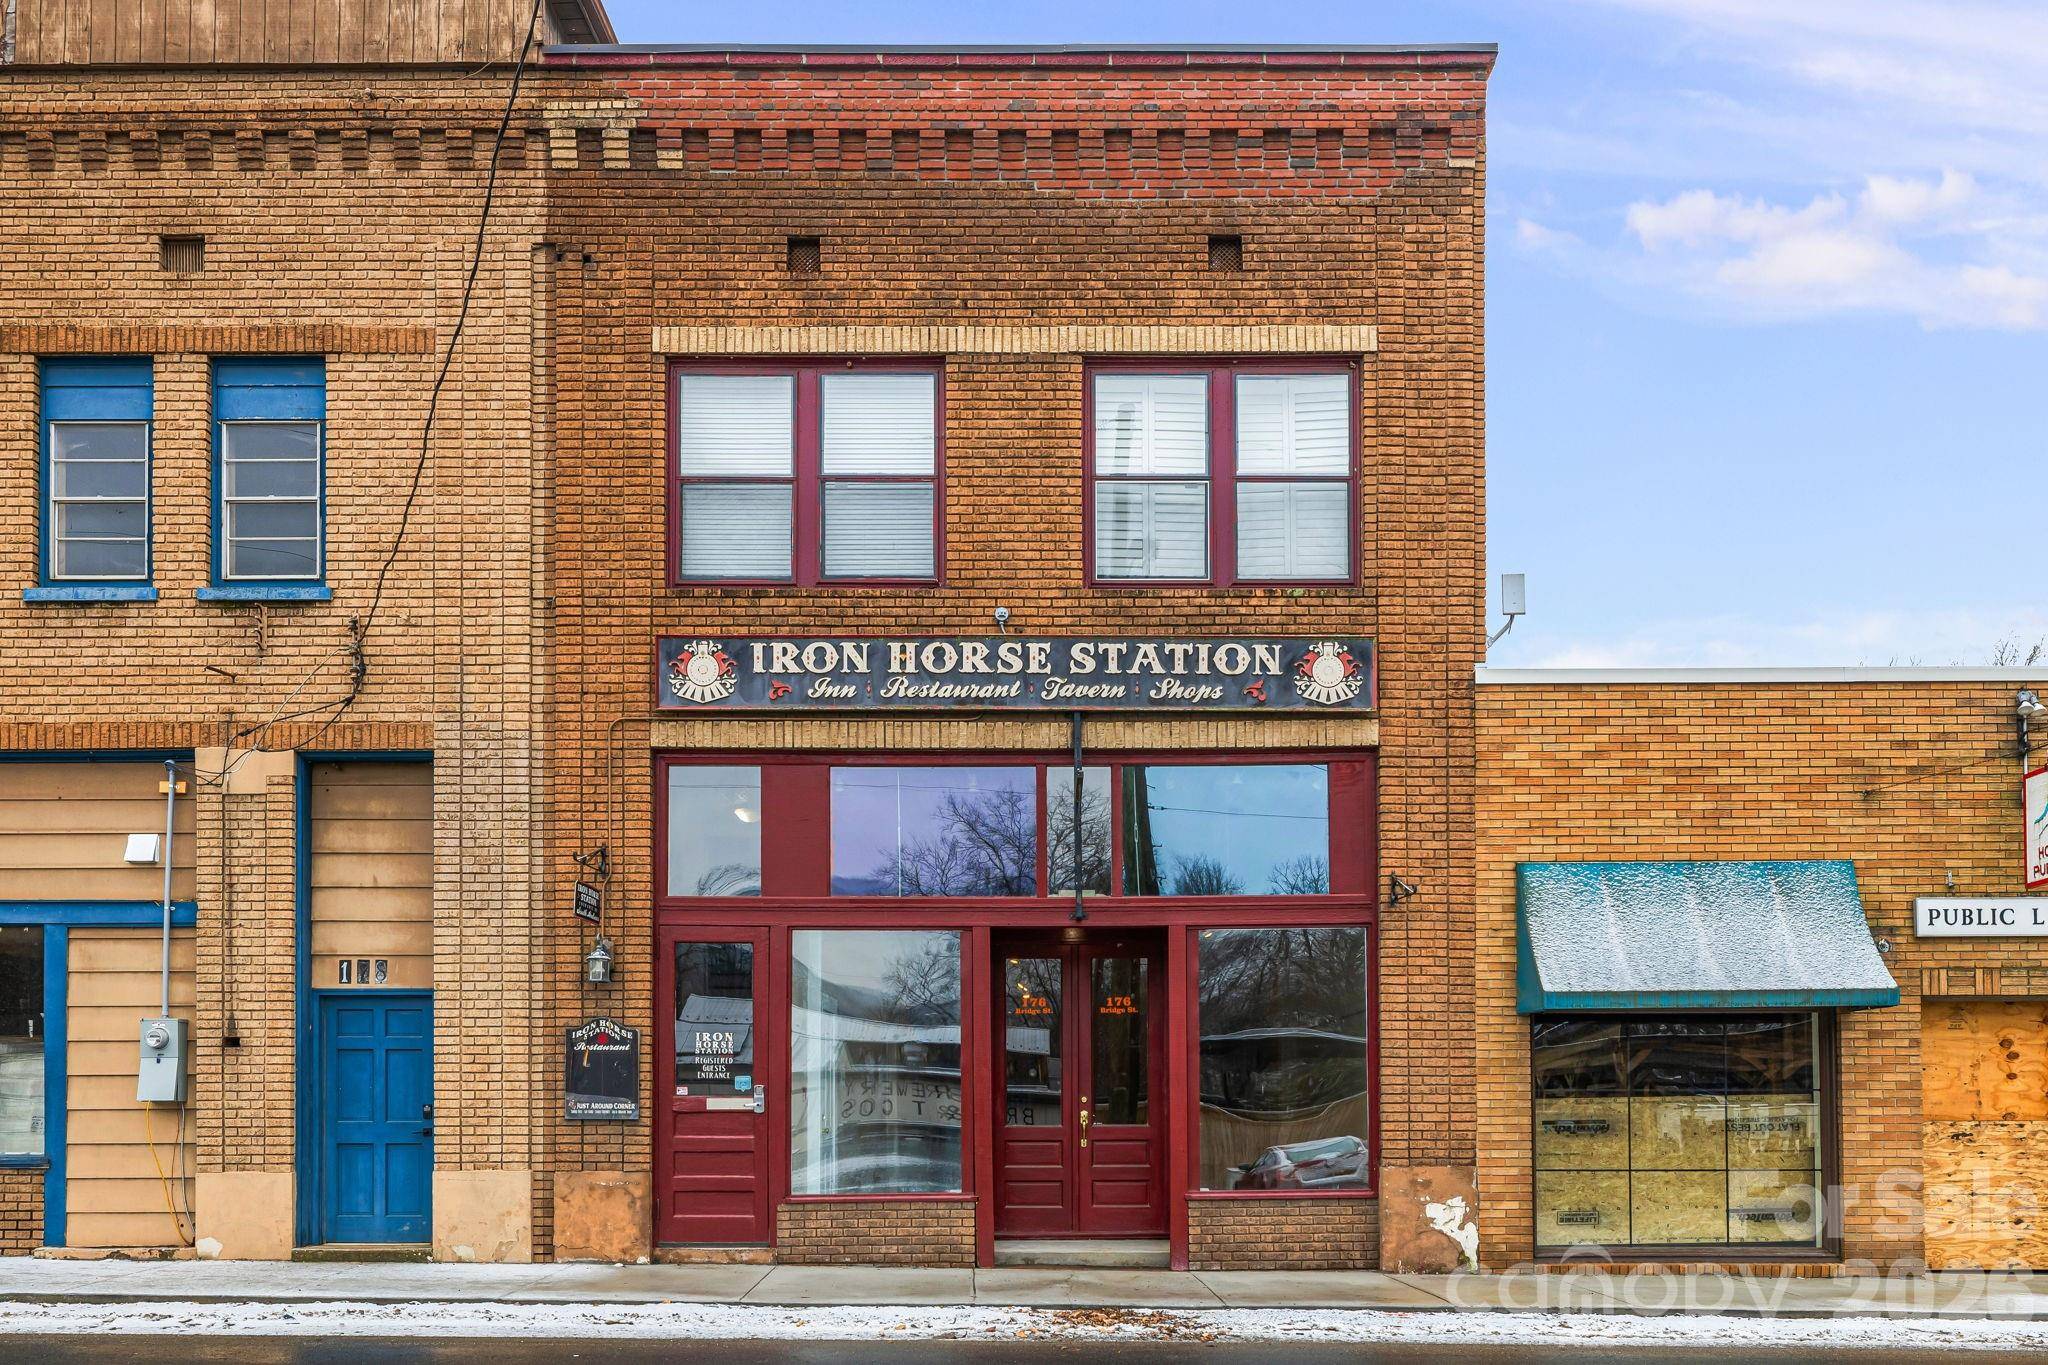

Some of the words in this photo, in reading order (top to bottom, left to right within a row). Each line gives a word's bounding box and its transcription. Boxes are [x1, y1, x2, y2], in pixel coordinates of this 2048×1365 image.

[750, 642, 871, 673] IRON
[887, 641, 1051, 675] HORSE
[1069, 642, 1283, 675] STATION
[807, 677, 857, 698] Inn
[880, 676, 1021, 698] Restaurant
[1041, 677, 1126, 700] Tavern
[1150, 678, 1223, 703] Shops
[1928, 908, 2014, 926] PUBLIC
[2032, 908, 2045, 925] L
[1022, 998, 1046, 1007] 176
[1106, 996, 1131, 1006] 176
[1015, 1007, 1040, 1015] Bridge
[1100, 1007, 1125, 1015] Bridge
[572, 1022, 596, 1038] IRON
[599, 1020, 633, 1039] HORSE
[583, 1026, 620, 1041] STATION
[696, 1032, 733, 1041] IRON
[573, 1041, 630, 1051] Restaurant
